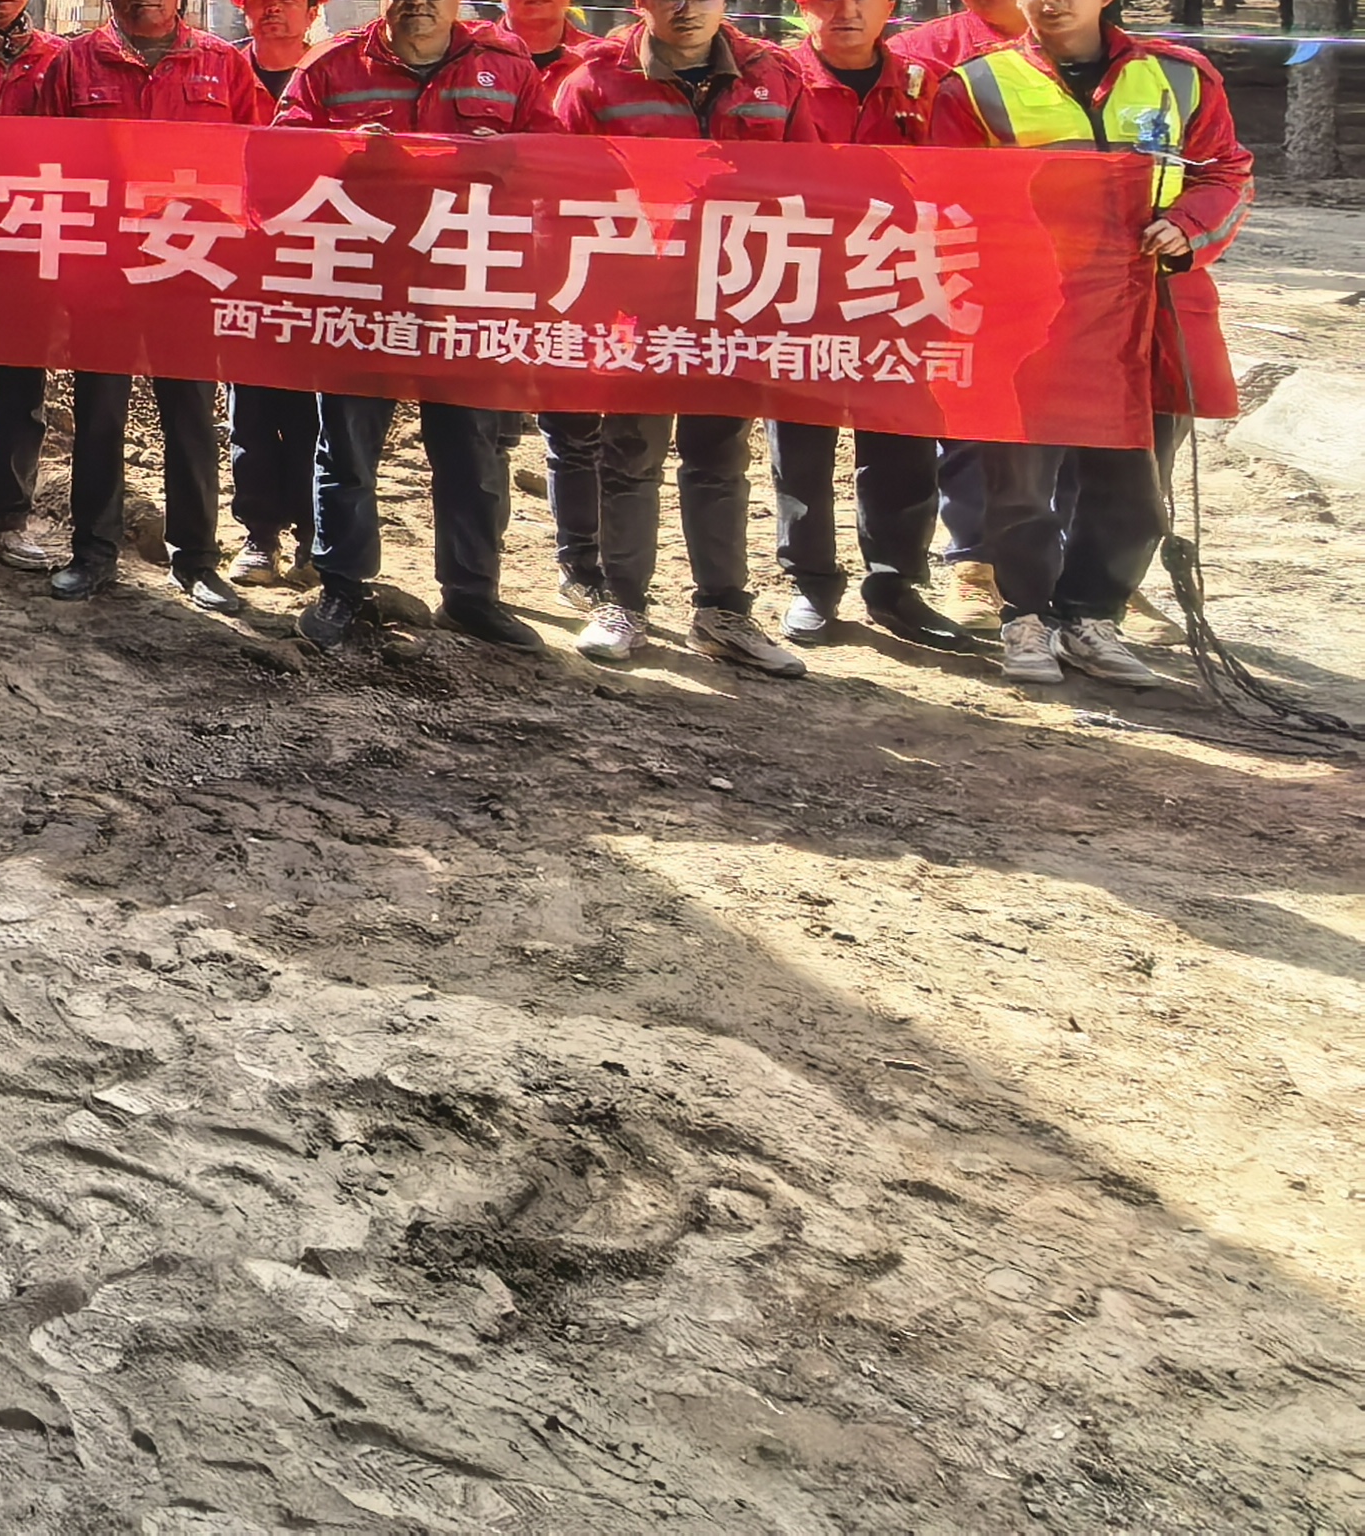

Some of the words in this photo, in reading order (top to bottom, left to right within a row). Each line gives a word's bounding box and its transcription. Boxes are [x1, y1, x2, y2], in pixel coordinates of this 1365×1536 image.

[211, 296, 973, 388] 西宁欣道市政建设养护有限公司
